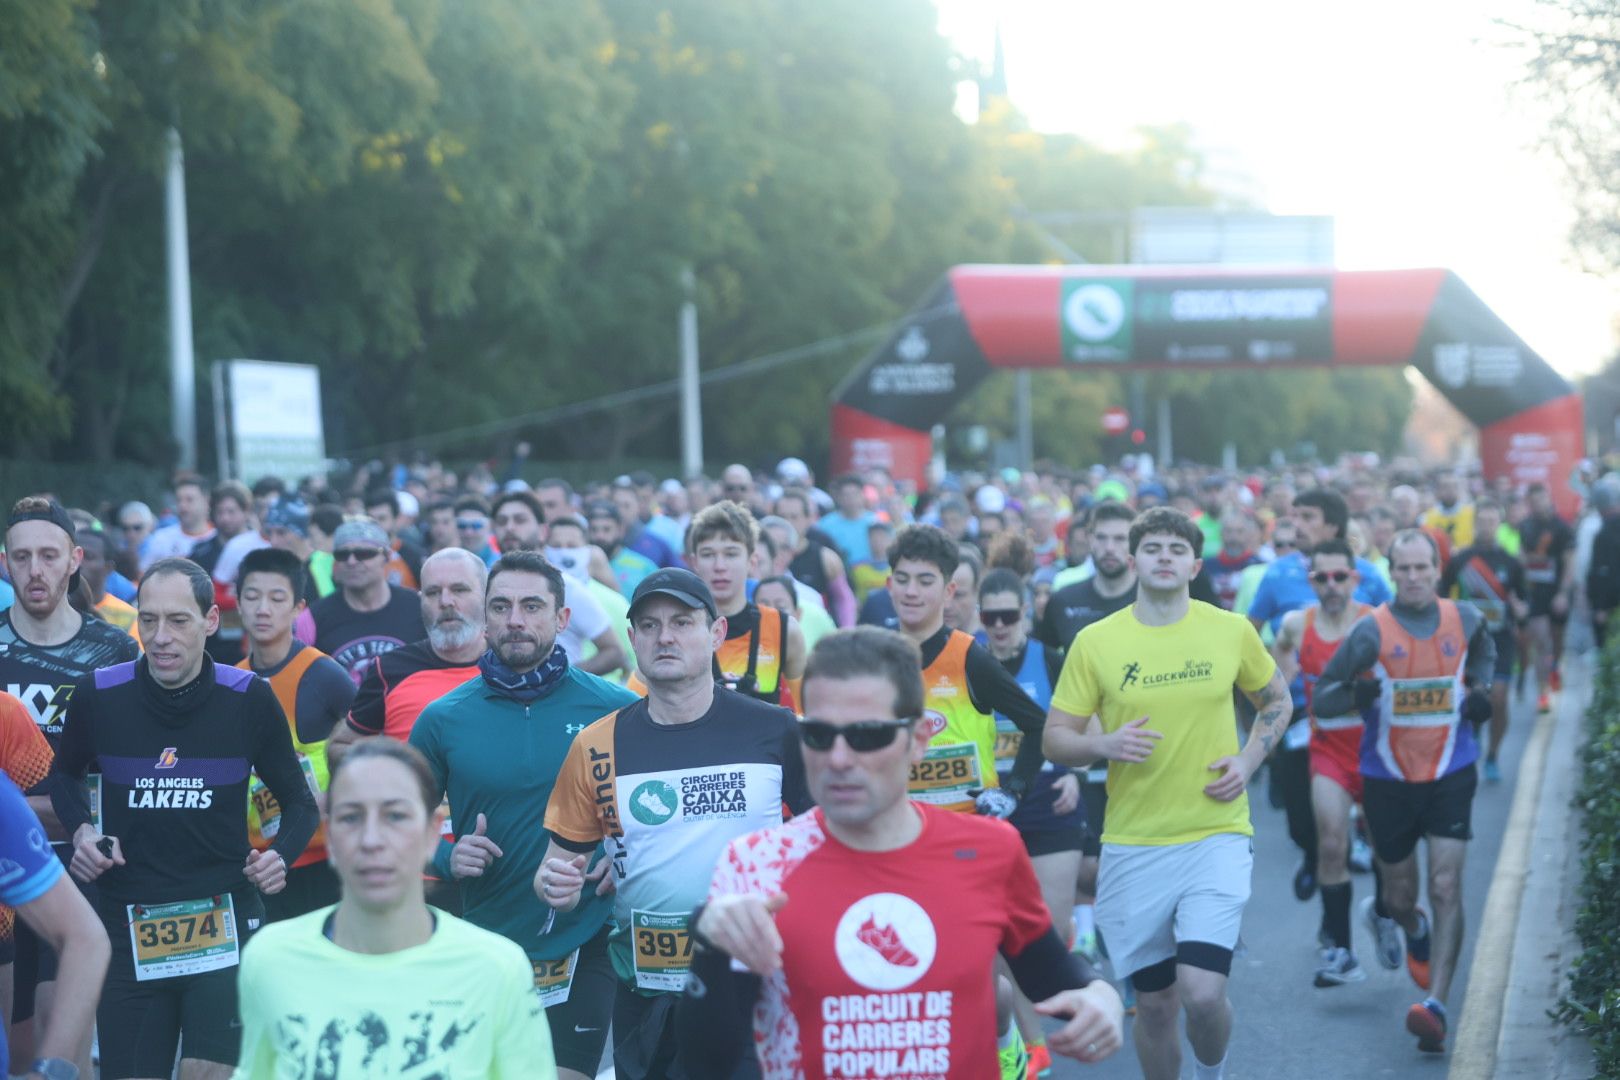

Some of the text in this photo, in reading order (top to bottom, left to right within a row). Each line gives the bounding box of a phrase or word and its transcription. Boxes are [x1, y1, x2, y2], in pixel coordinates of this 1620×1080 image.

[1143, 668, 1211, 685] CLOCKWORK
[681, 771, 745, 785] CIRCUIT DE
[909, 759, 968, 782] 3228
[135, 778, 204, 788] LOS ANGELES
[682, 780, 746, 793] CARRERES
[128, 790, 213, 809] LAKERS
[682, 789, 746, 806] CAIXA
[683, 802, 746, 816] POPULAR
[139, 913, 218, 948] 3374
[639, 930, 693, 957] 397
[822, 990, 953, 1022] CIRCUIT DE
[823, 1018, 951, 1050] CARRERES
[823, 1046, 951, 1077] POPULARS
